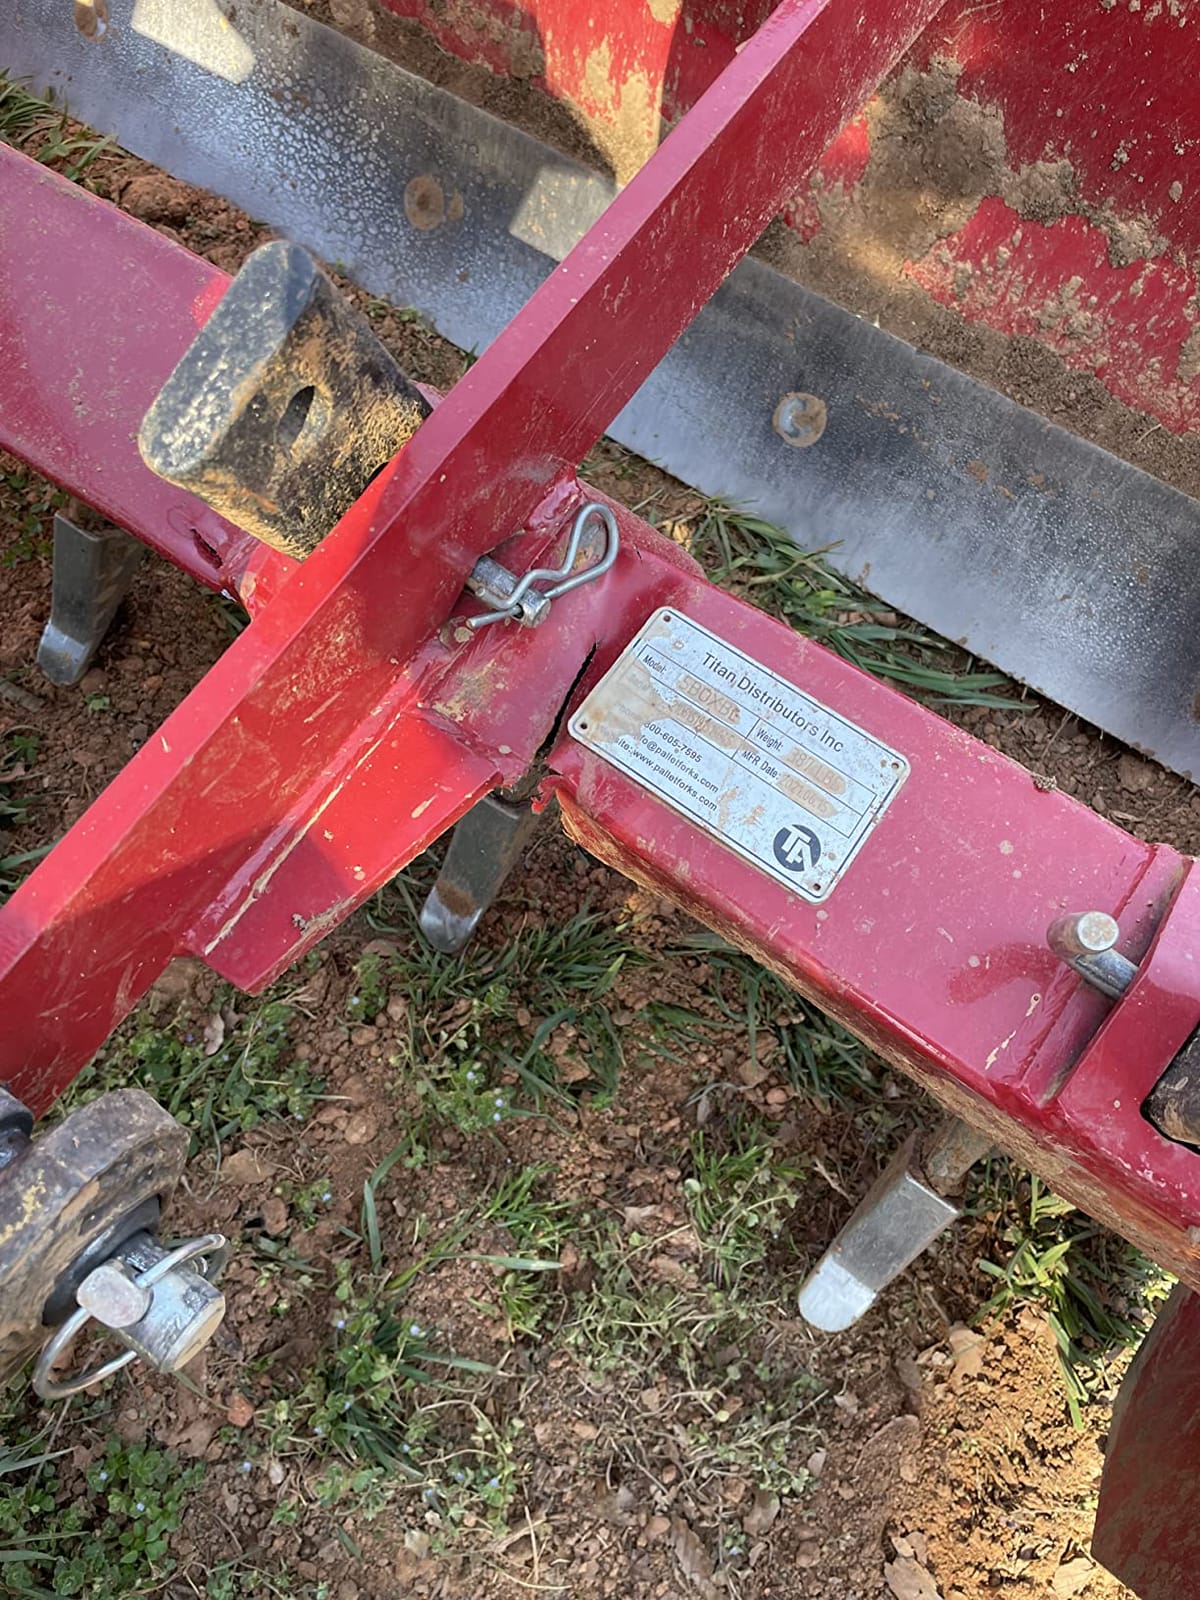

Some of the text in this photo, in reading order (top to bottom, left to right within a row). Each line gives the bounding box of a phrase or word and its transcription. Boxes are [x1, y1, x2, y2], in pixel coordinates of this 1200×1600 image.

[642, 654, 668, 675] Model:
[700, 652, 737, 682] Titan
[736, 675, 820, 736] Distributors
[819, 729, 846, 753] Inc
[754, 728, 784, 753] Weight:
[741, 748, 761, 765] MFR
[759, 761, 781, 779] Date:
